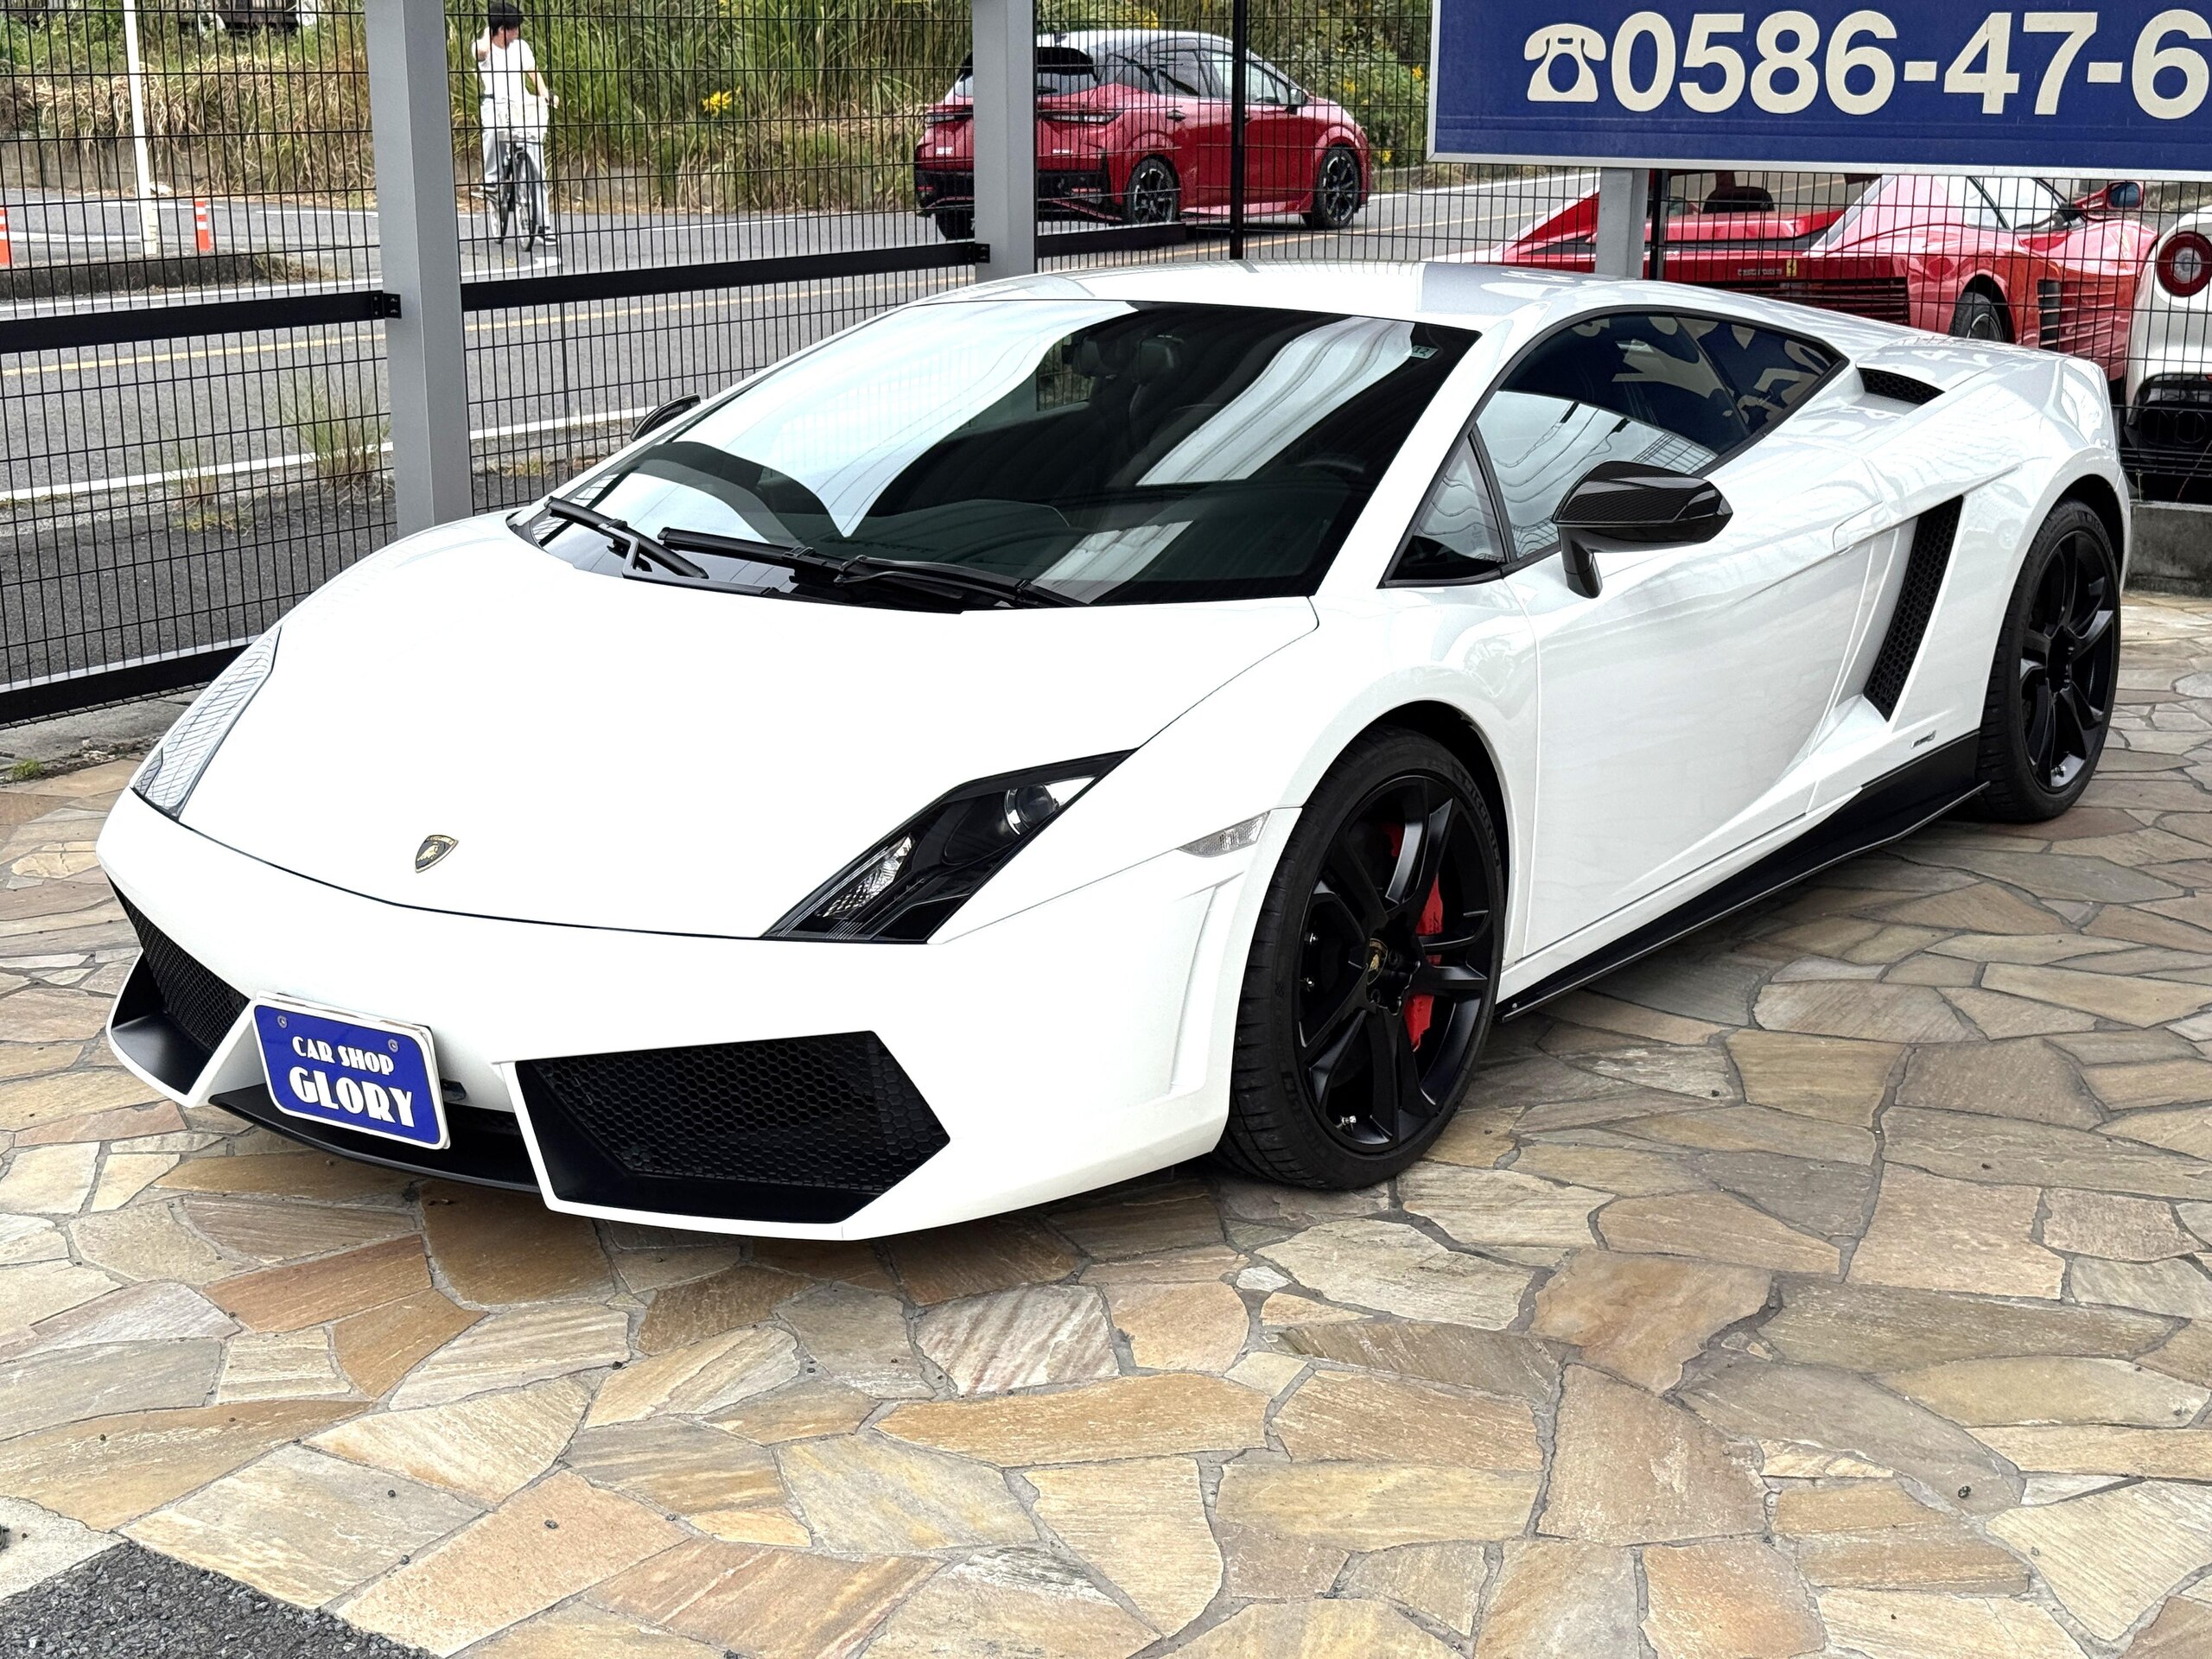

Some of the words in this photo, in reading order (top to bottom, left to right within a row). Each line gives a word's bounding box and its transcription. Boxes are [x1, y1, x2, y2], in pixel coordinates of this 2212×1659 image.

[1611, 10, 2212, 120] 0586-47-6
[292, 1036, 335, 1064] CAR
[338, 1045, 395, 1077] SHOP
[289, 1066, 416, 1128] GLORY
